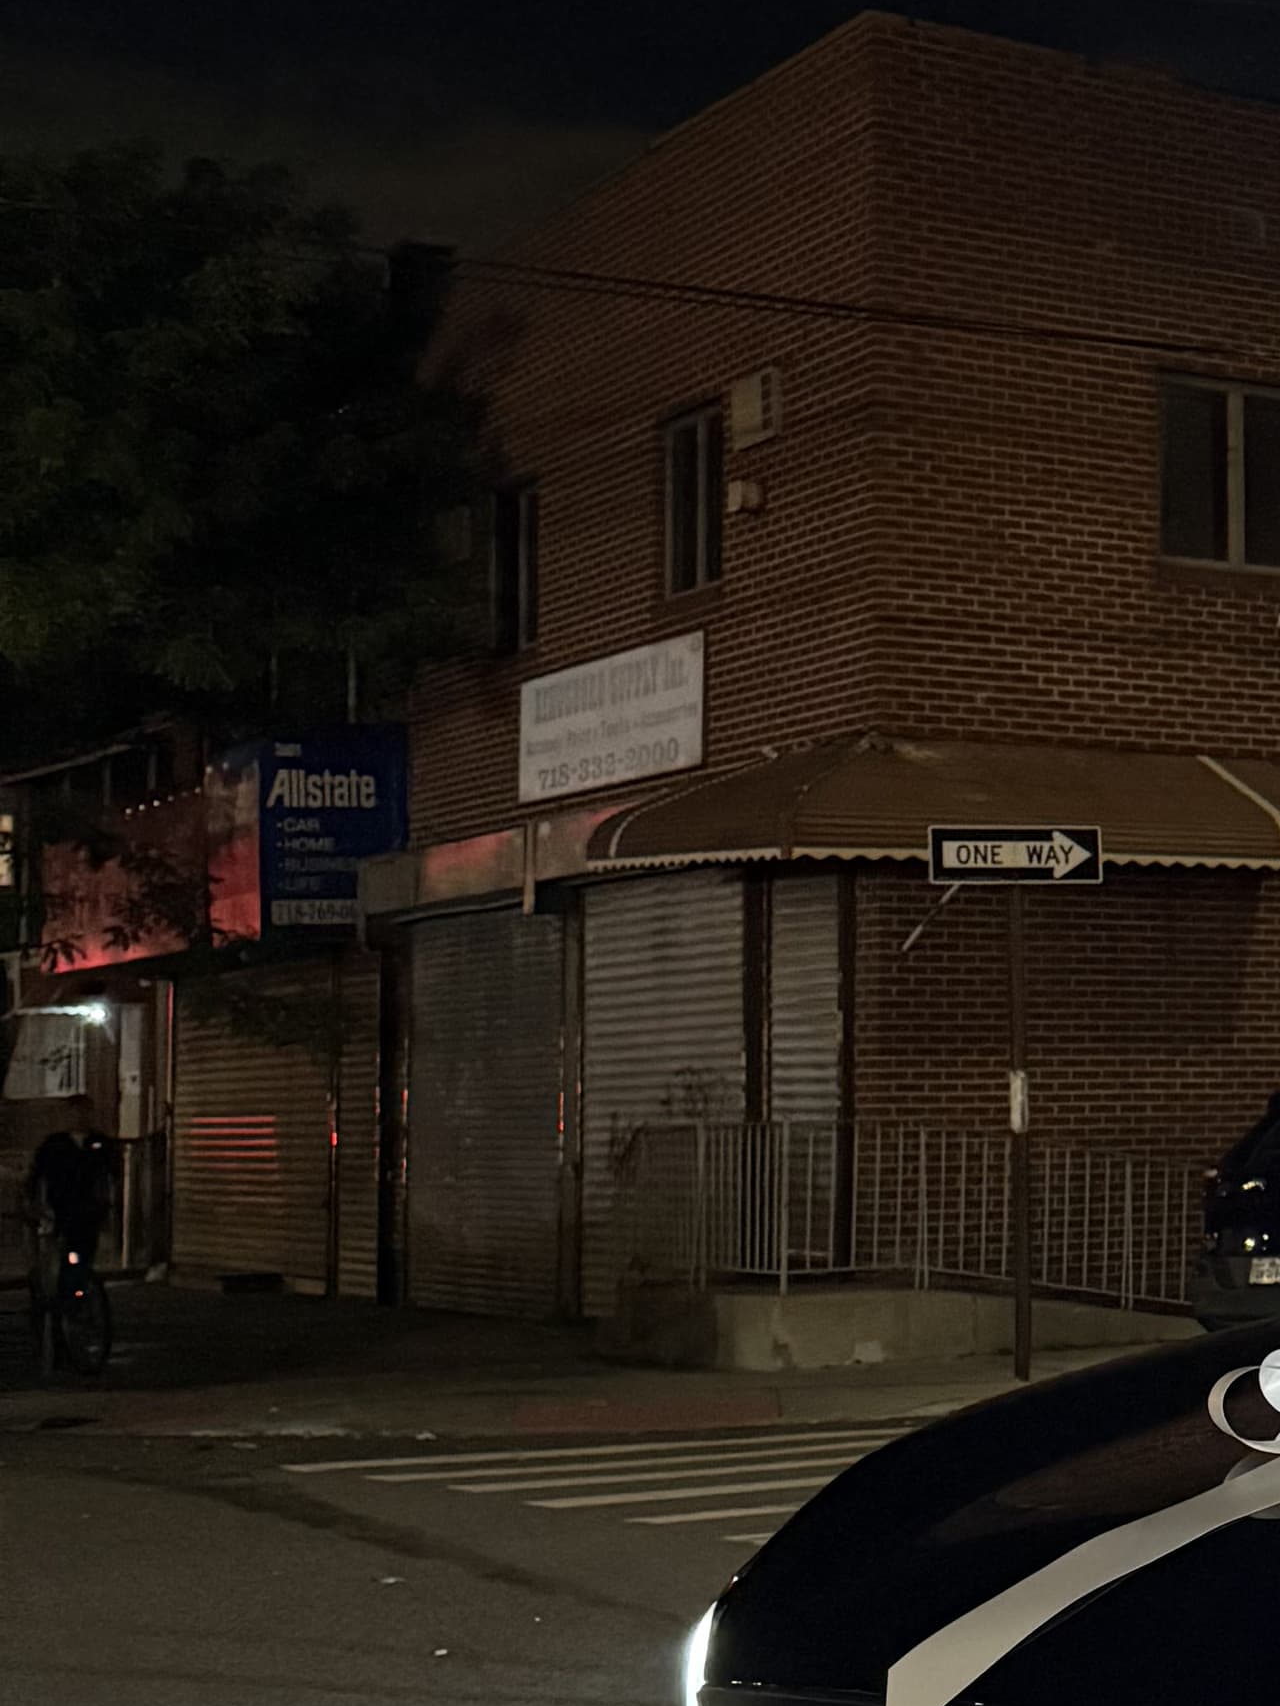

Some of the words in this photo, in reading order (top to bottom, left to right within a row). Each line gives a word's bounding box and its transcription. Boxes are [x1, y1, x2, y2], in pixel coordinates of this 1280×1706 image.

[266, 768, 376, 809] Allstate
[284, 818, 320, 832] CAR
[956, 845, 1003, 865] ONE
[1026, 845, 1073, 865] WAY
